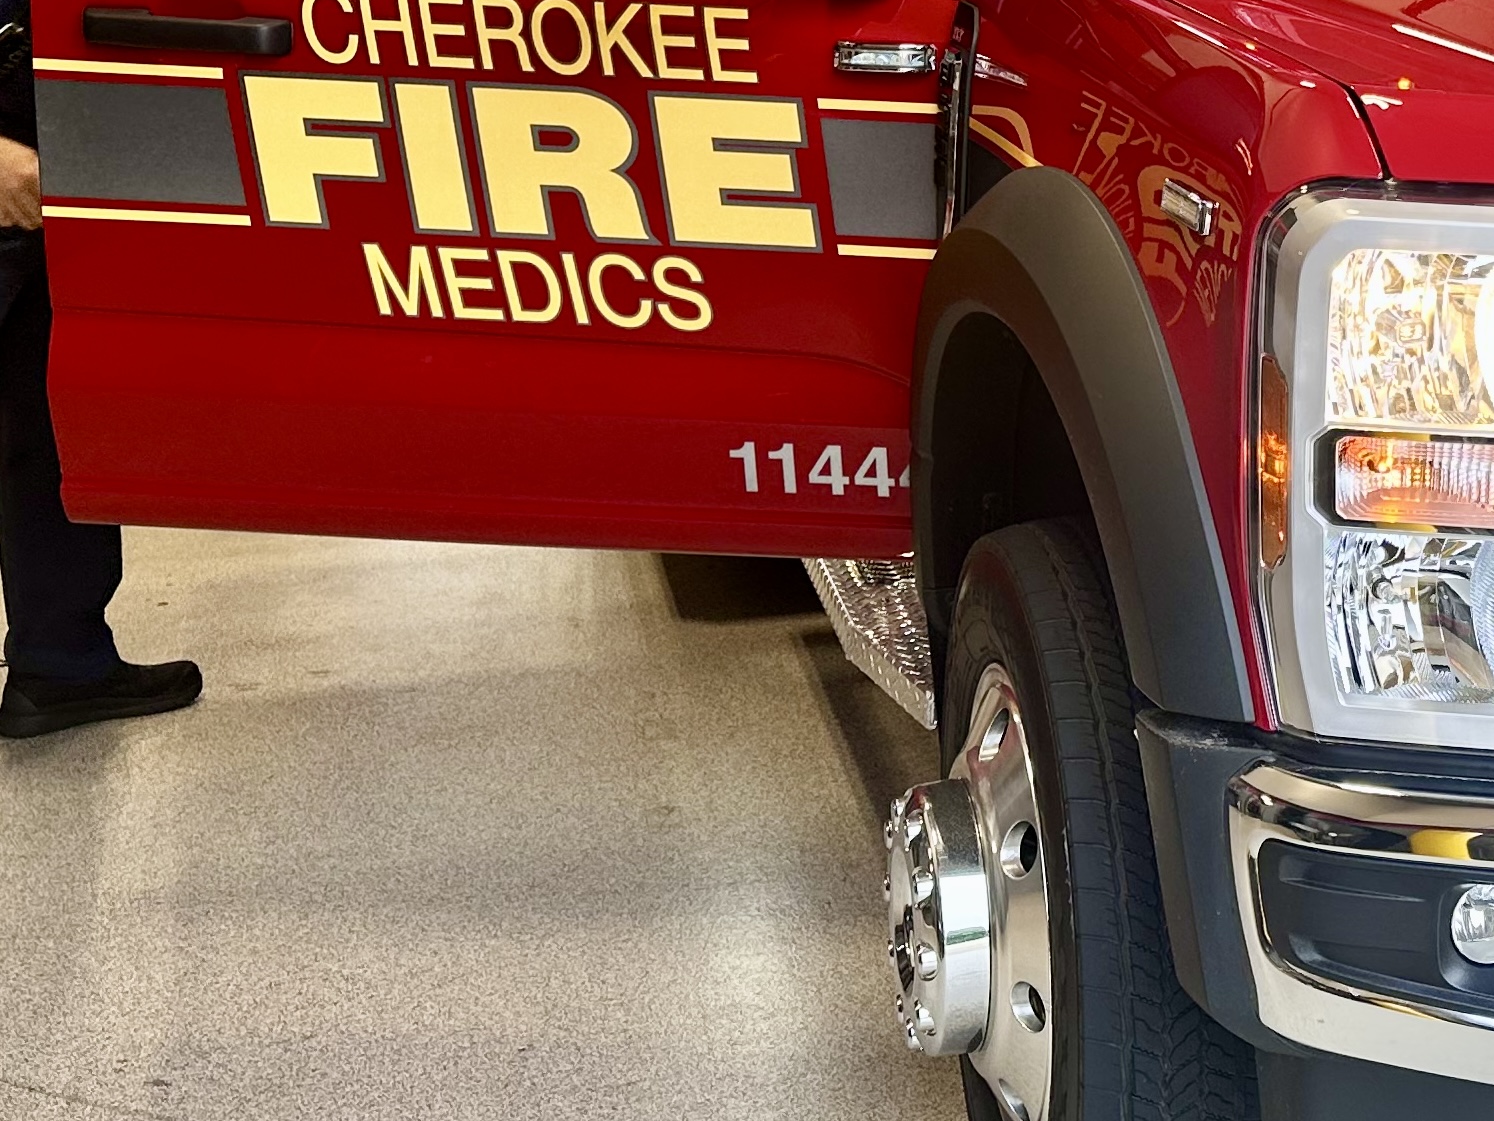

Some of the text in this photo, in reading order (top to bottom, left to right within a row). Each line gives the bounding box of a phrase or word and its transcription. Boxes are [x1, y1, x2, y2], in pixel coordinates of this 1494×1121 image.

[241, 71, 820, 251] FIRE
[361, 242, 714, 332] MEDICS
[729, 441, 911, 497] 1144
